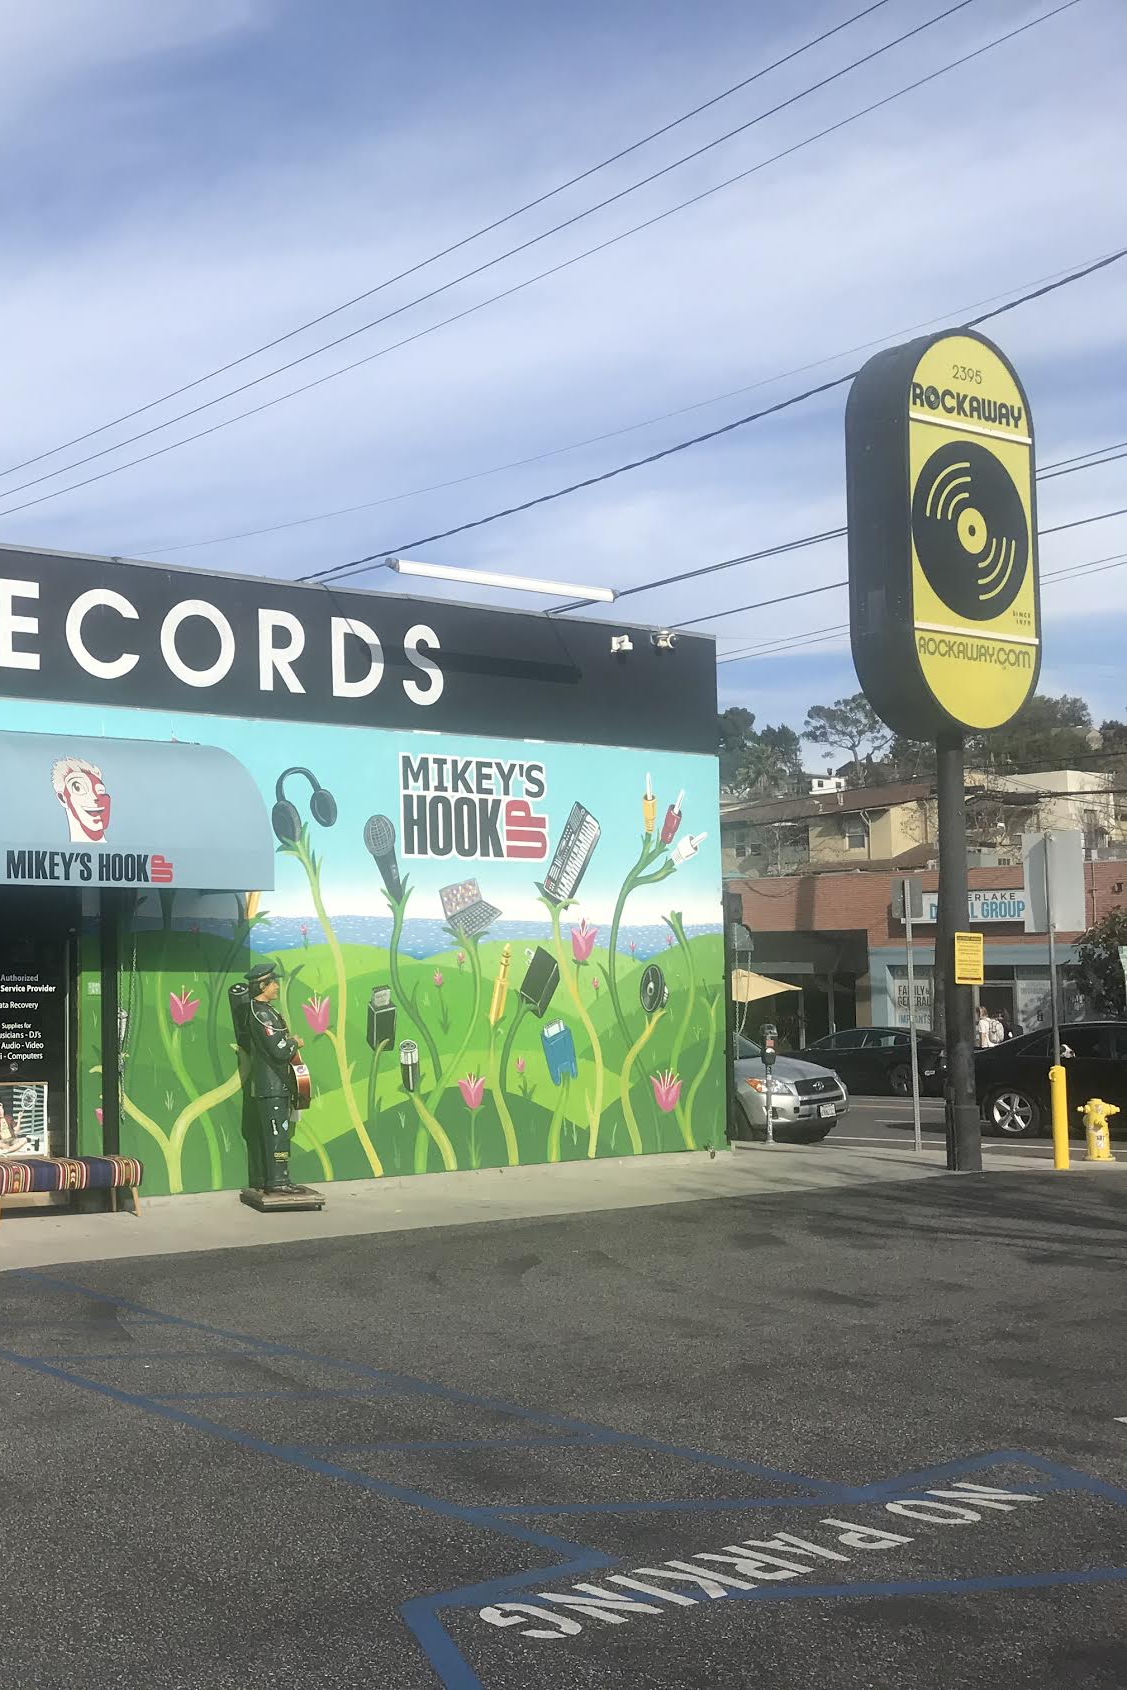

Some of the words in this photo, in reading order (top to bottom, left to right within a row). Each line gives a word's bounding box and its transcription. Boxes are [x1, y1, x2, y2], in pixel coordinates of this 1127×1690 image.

[952, 365, 983, 385] 2395
[912, 381, 1022, 428] ROCKAWAY
[918, 636, 1031, 669] ROCKAWAY.COM
[401, 755, 545, 798] MIKEY'S
[403, 794, 504, 859] HOOK
[505, 799, 548, 860] UP
[6, 850, 93, 882] MIKEY'S
[98, 853, 150, 882] HOOK
[150, 854, 173, 883] UP
[968, 892, 1016, 902] ERLAKE
[980, 900, 1026, 918] GROUP
[0, 974, 39, 982] Authorized
[0, 985, 26, 993] Service
[26, 985, 56, 993] Provider
[10, 1001, 39, 1010] Recovery
[897, 996, 930, 1007] GERAL
[1, 1022, 23, 1030] Supplies
[29, 1031, 42, 1039] DJ's
[1, 1041, 21, 1049] Audio
[25, 1041, 45, 1049] Video
[7, 1052, 43, 1061] Computers
[884, 1481, 1044, 1525] NO
[480, 1518, 915, 1640] PARKING
